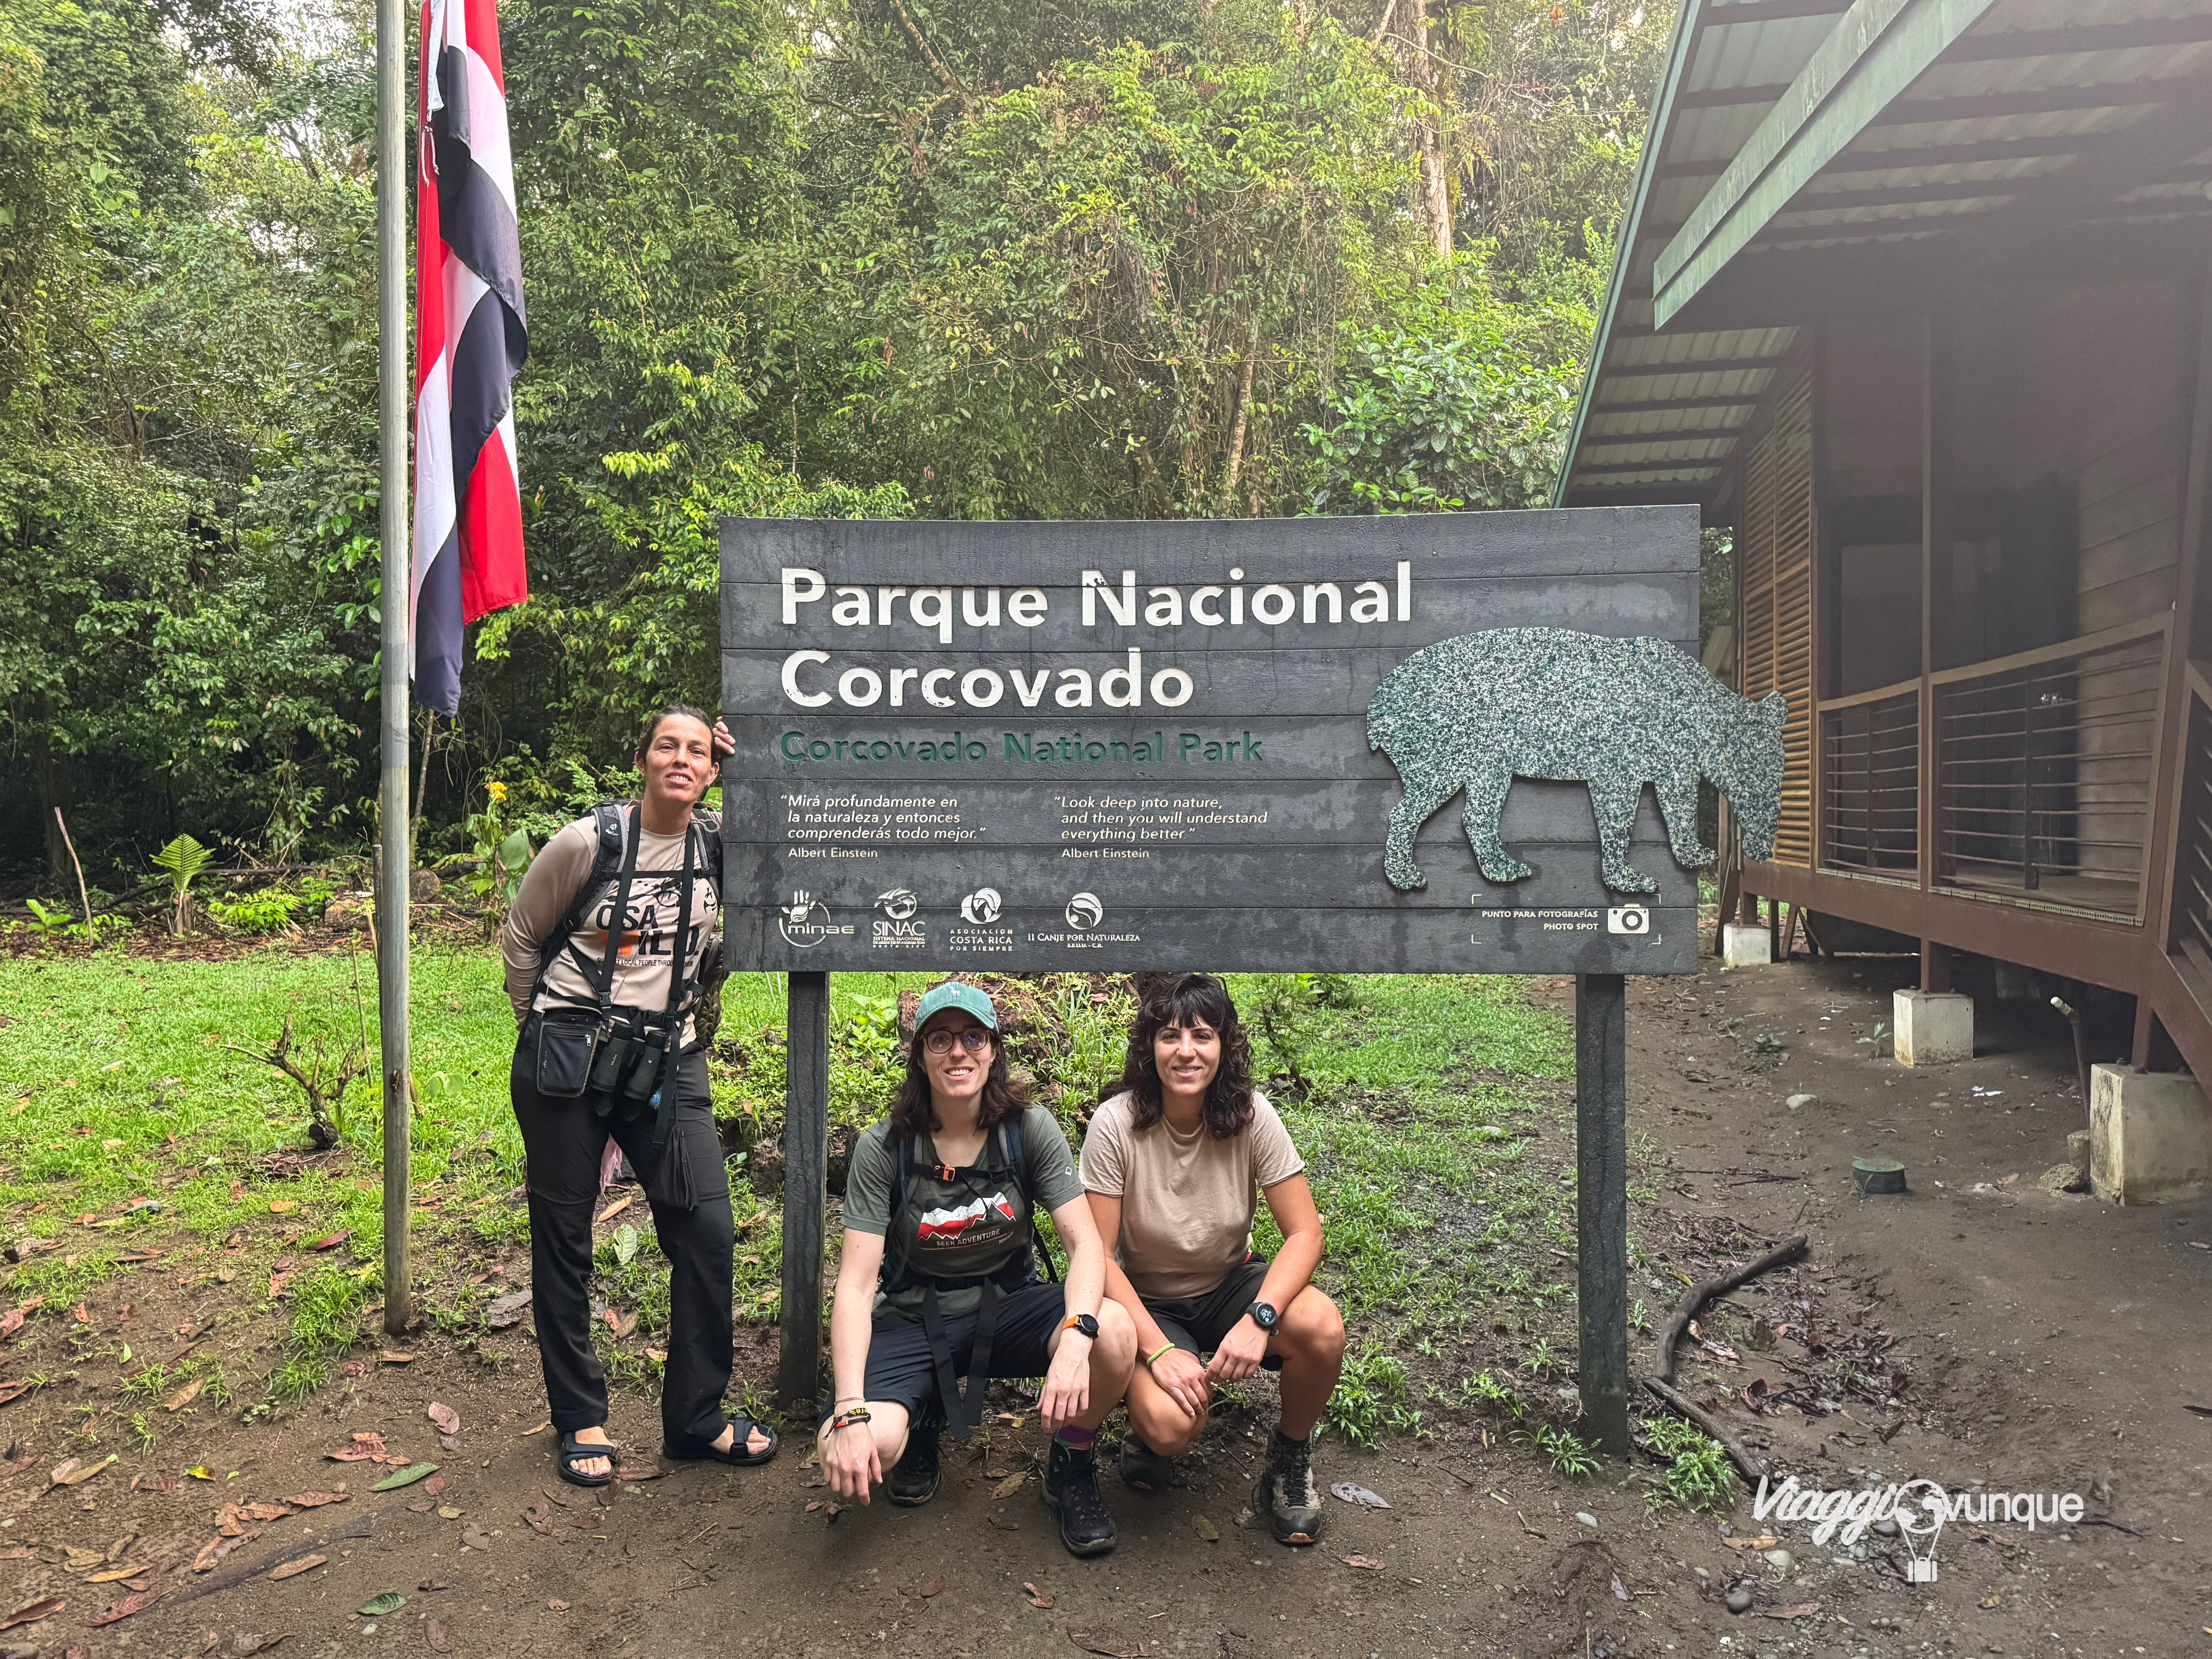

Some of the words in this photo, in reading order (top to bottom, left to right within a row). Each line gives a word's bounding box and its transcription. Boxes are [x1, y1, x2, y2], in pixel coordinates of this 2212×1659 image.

[782, 567, 1048, 644] Parque
[1082, 560, 1411, 627] Nacional
[781, 647, 1194, 708] Corcovado
[780, 731, 988, 763] Corcovado
[1003, 730, 1163, 763] National
[1179, 731, 1264, 762] Park
[825, 794, 936, 811] profundamente
[940, 798, 957, 808] en
[1099, 796, 1136, 811] deep
[1141, 796, 1169, 808] into
[1173, 797, 1222, 810] nature,
[788, 810, 800, 822] la
[805, 810, 879, 823] naturaleza
[883, 814, 892, 826] y
[896, 812, 960, 823] entonces
[1062, 811, 1088, 823] and
[1092, 811, 1124, 823] then
[1128, 815, 1154, 827] you
[1159, 811, 1182, 823] will
[1187, 811, 1268, 823] understand
[788, 825, 891, 842] comprenderás
[895, 826, 929, 839] todo
[1061, 827, 1136, 842] everything
[788, 848, 826, 857] Albert
[831, 848, 878, 857] Einstein
[1062, 848, 1098, 858] Albert
[1103, 848, 1149, 858] Einstein
[1538, 909, 1598, 918] FOTOGRAFÍAS
[872, 921, 926, 936] SINAC
[950, 936, 984, 944] COSTA
[988, 936, 1013, 944] RICA
[1037, 933, 1064, 943] CANJE
[957, 1228, 1001, 1245] ADVENTURE
